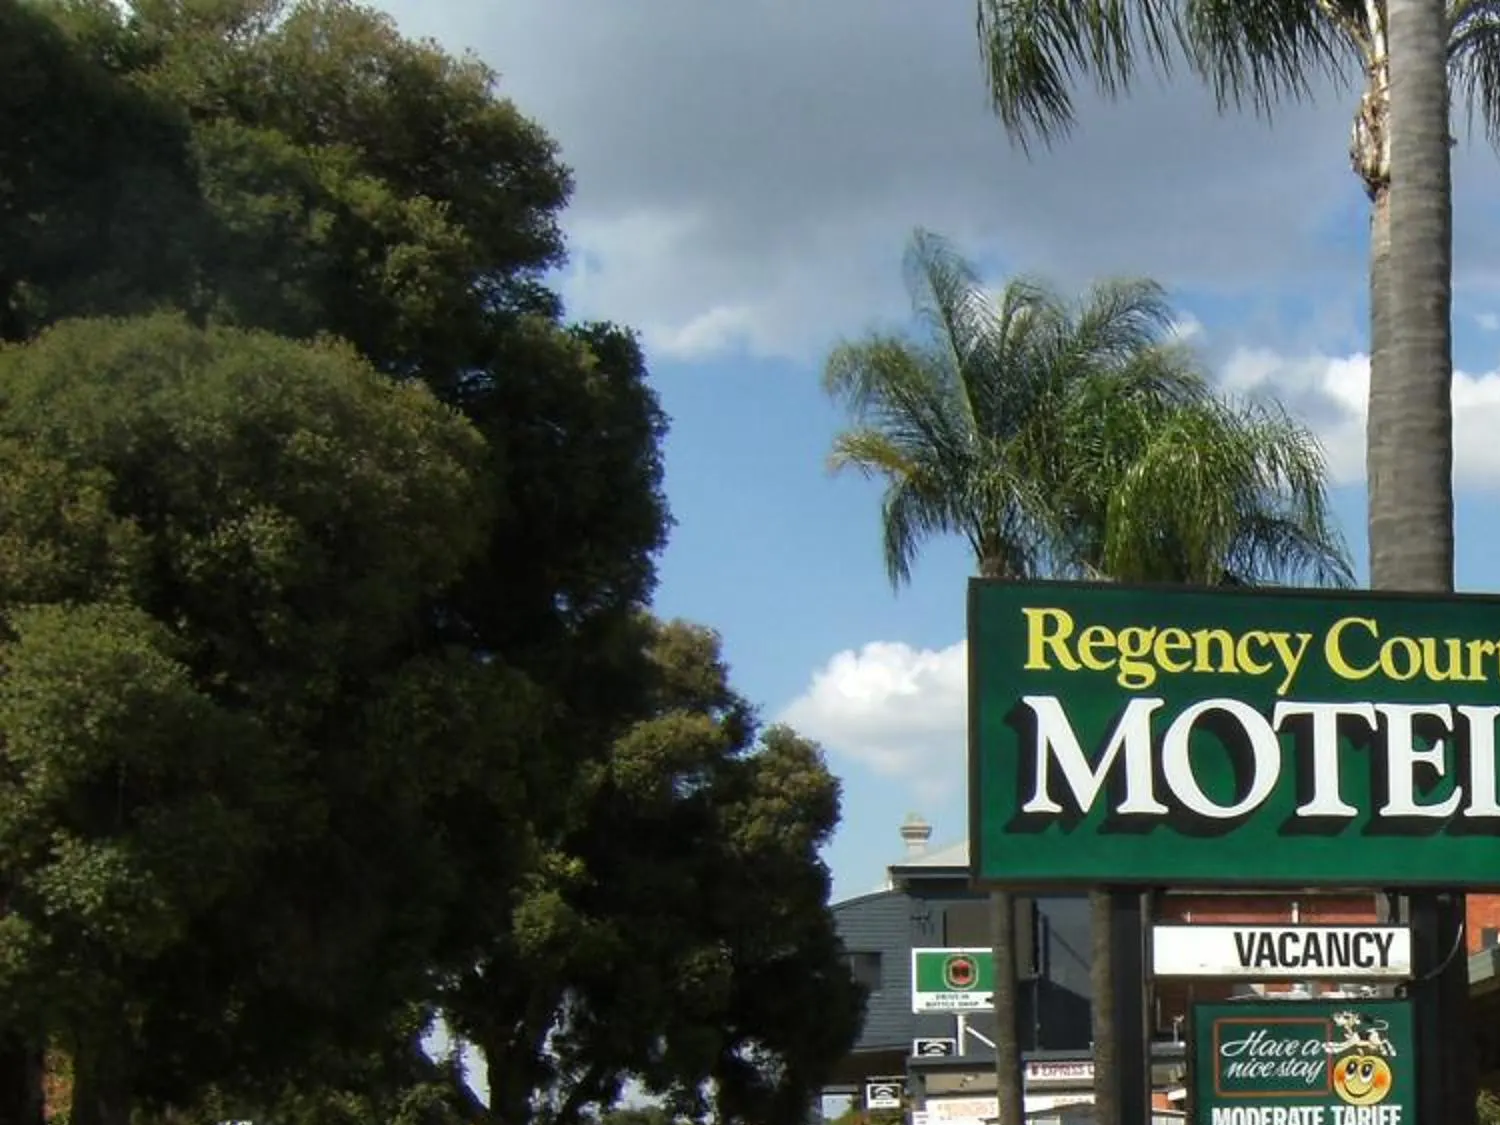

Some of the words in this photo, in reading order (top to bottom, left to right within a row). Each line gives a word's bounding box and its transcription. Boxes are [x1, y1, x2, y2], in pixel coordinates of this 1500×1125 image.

[1022, 608, 1312, 695] Regency
[1234, 931, 1395, 968] VACANCY
[1221, 1029, 1298, 1057] Have
[1300, 1037, 1322, 1056] a
[1227, 1056, 1273, 1079] nice
[1276, 1054, 1327, 1084] stay
